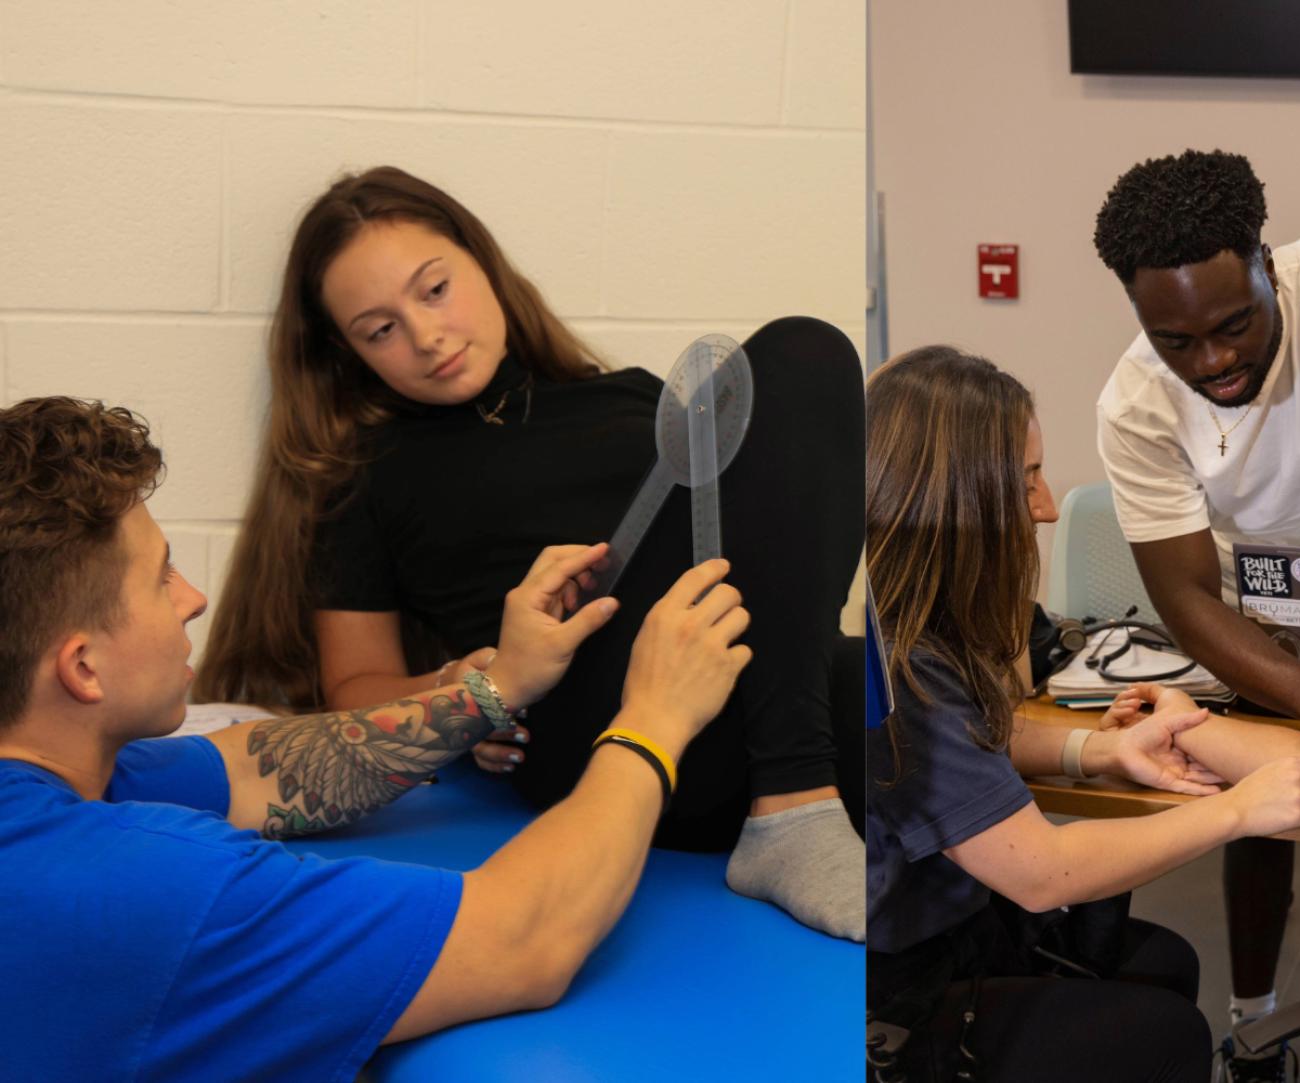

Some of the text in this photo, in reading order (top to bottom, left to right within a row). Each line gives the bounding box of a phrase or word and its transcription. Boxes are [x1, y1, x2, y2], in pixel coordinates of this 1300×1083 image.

[1241, 557, 1286, 571] BUILT
[1246, 569, 1286, 580] FOR THE
[1244, 575, 1289, 593] WILD.
